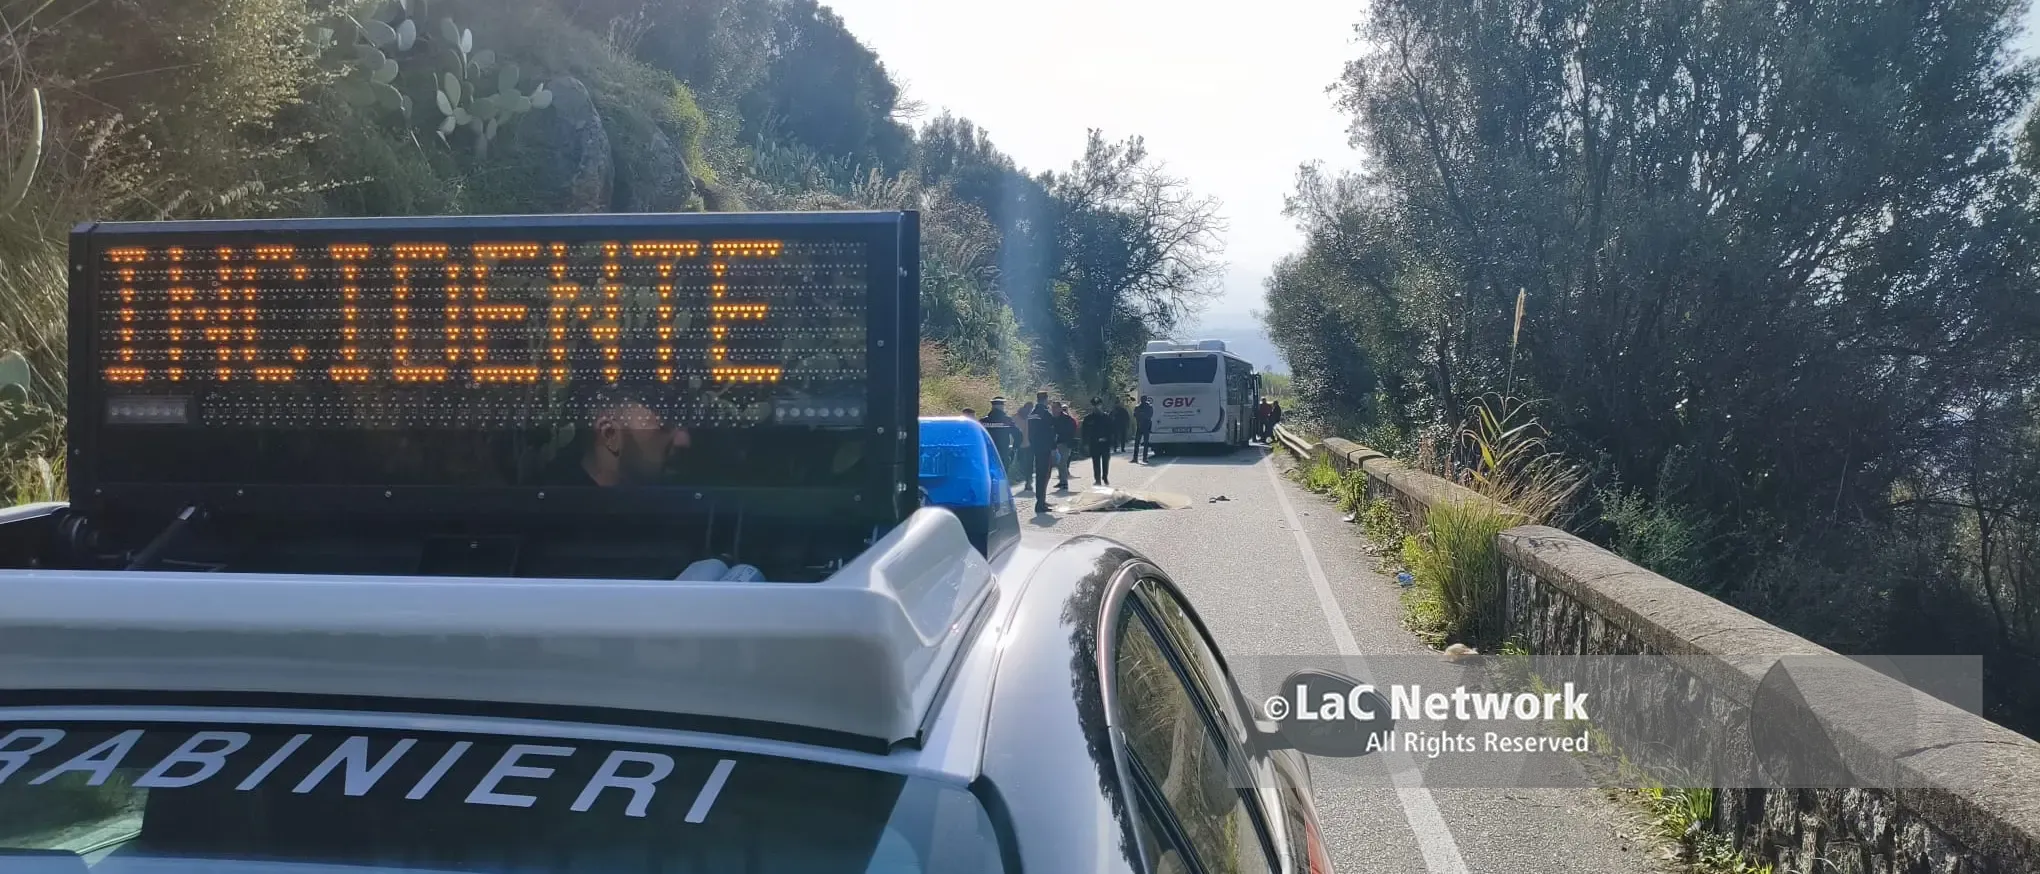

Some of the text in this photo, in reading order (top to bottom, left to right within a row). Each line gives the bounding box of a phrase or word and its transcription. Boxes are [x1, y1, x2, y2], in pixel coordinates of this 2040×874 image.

[102, 240, 784, 384] INCIDENTE
[1162, 397, 1196, 408] GBV
[0, 728, 737, 823] RABINIERI
